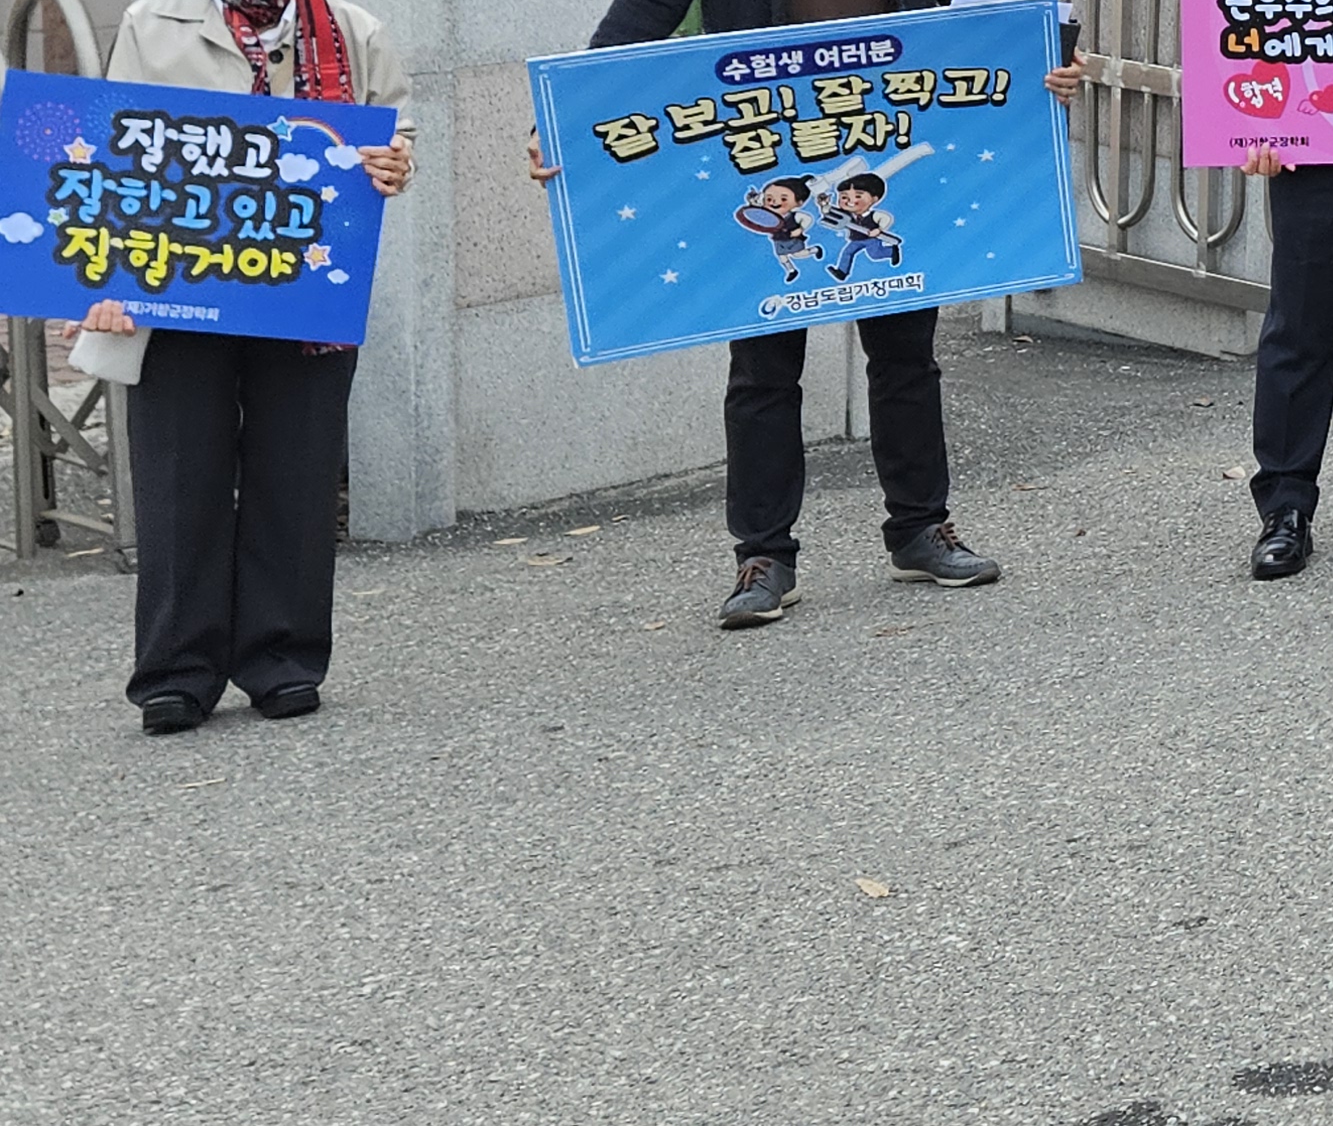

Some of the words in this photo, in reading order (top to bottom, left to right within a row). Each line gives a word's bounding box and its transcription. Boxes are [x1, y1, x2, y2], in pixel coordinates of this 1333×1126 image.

[722, 51, 805, 82] 수험생
[814, 38, 896, 69] 여러분
[595, 114, 658, 162] 잘
[666, 85, 797, 142] 보고!
[813, 76, 873, 119] 잘
[883, 69, 1011, 107] 찍고!
[1241, 77, 1283, 109] 합격
[117, 117, 273, 179] 잘했고
[726, 130, 783, 174] 잘
[792, 112, 911, 162] 풀자!
[55, 169, 212, 229] 잘하고
[232, 189, 316, 241] 있고
